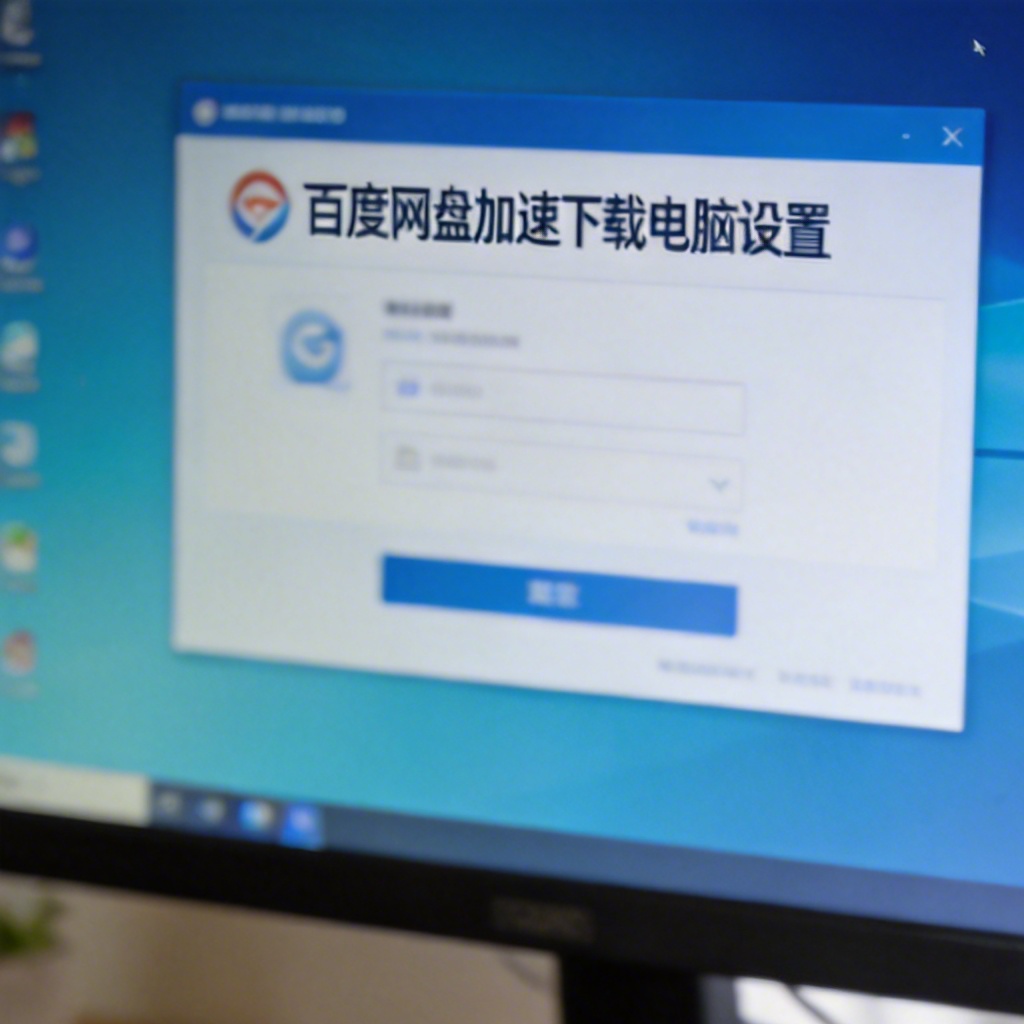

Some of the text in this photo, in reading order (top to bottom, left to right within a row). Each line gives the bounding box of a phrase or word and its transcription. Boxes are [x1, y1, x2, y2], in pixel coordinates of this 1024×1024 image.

[303, 182, 831, 259] 百度网盘加速下载电脑设置
